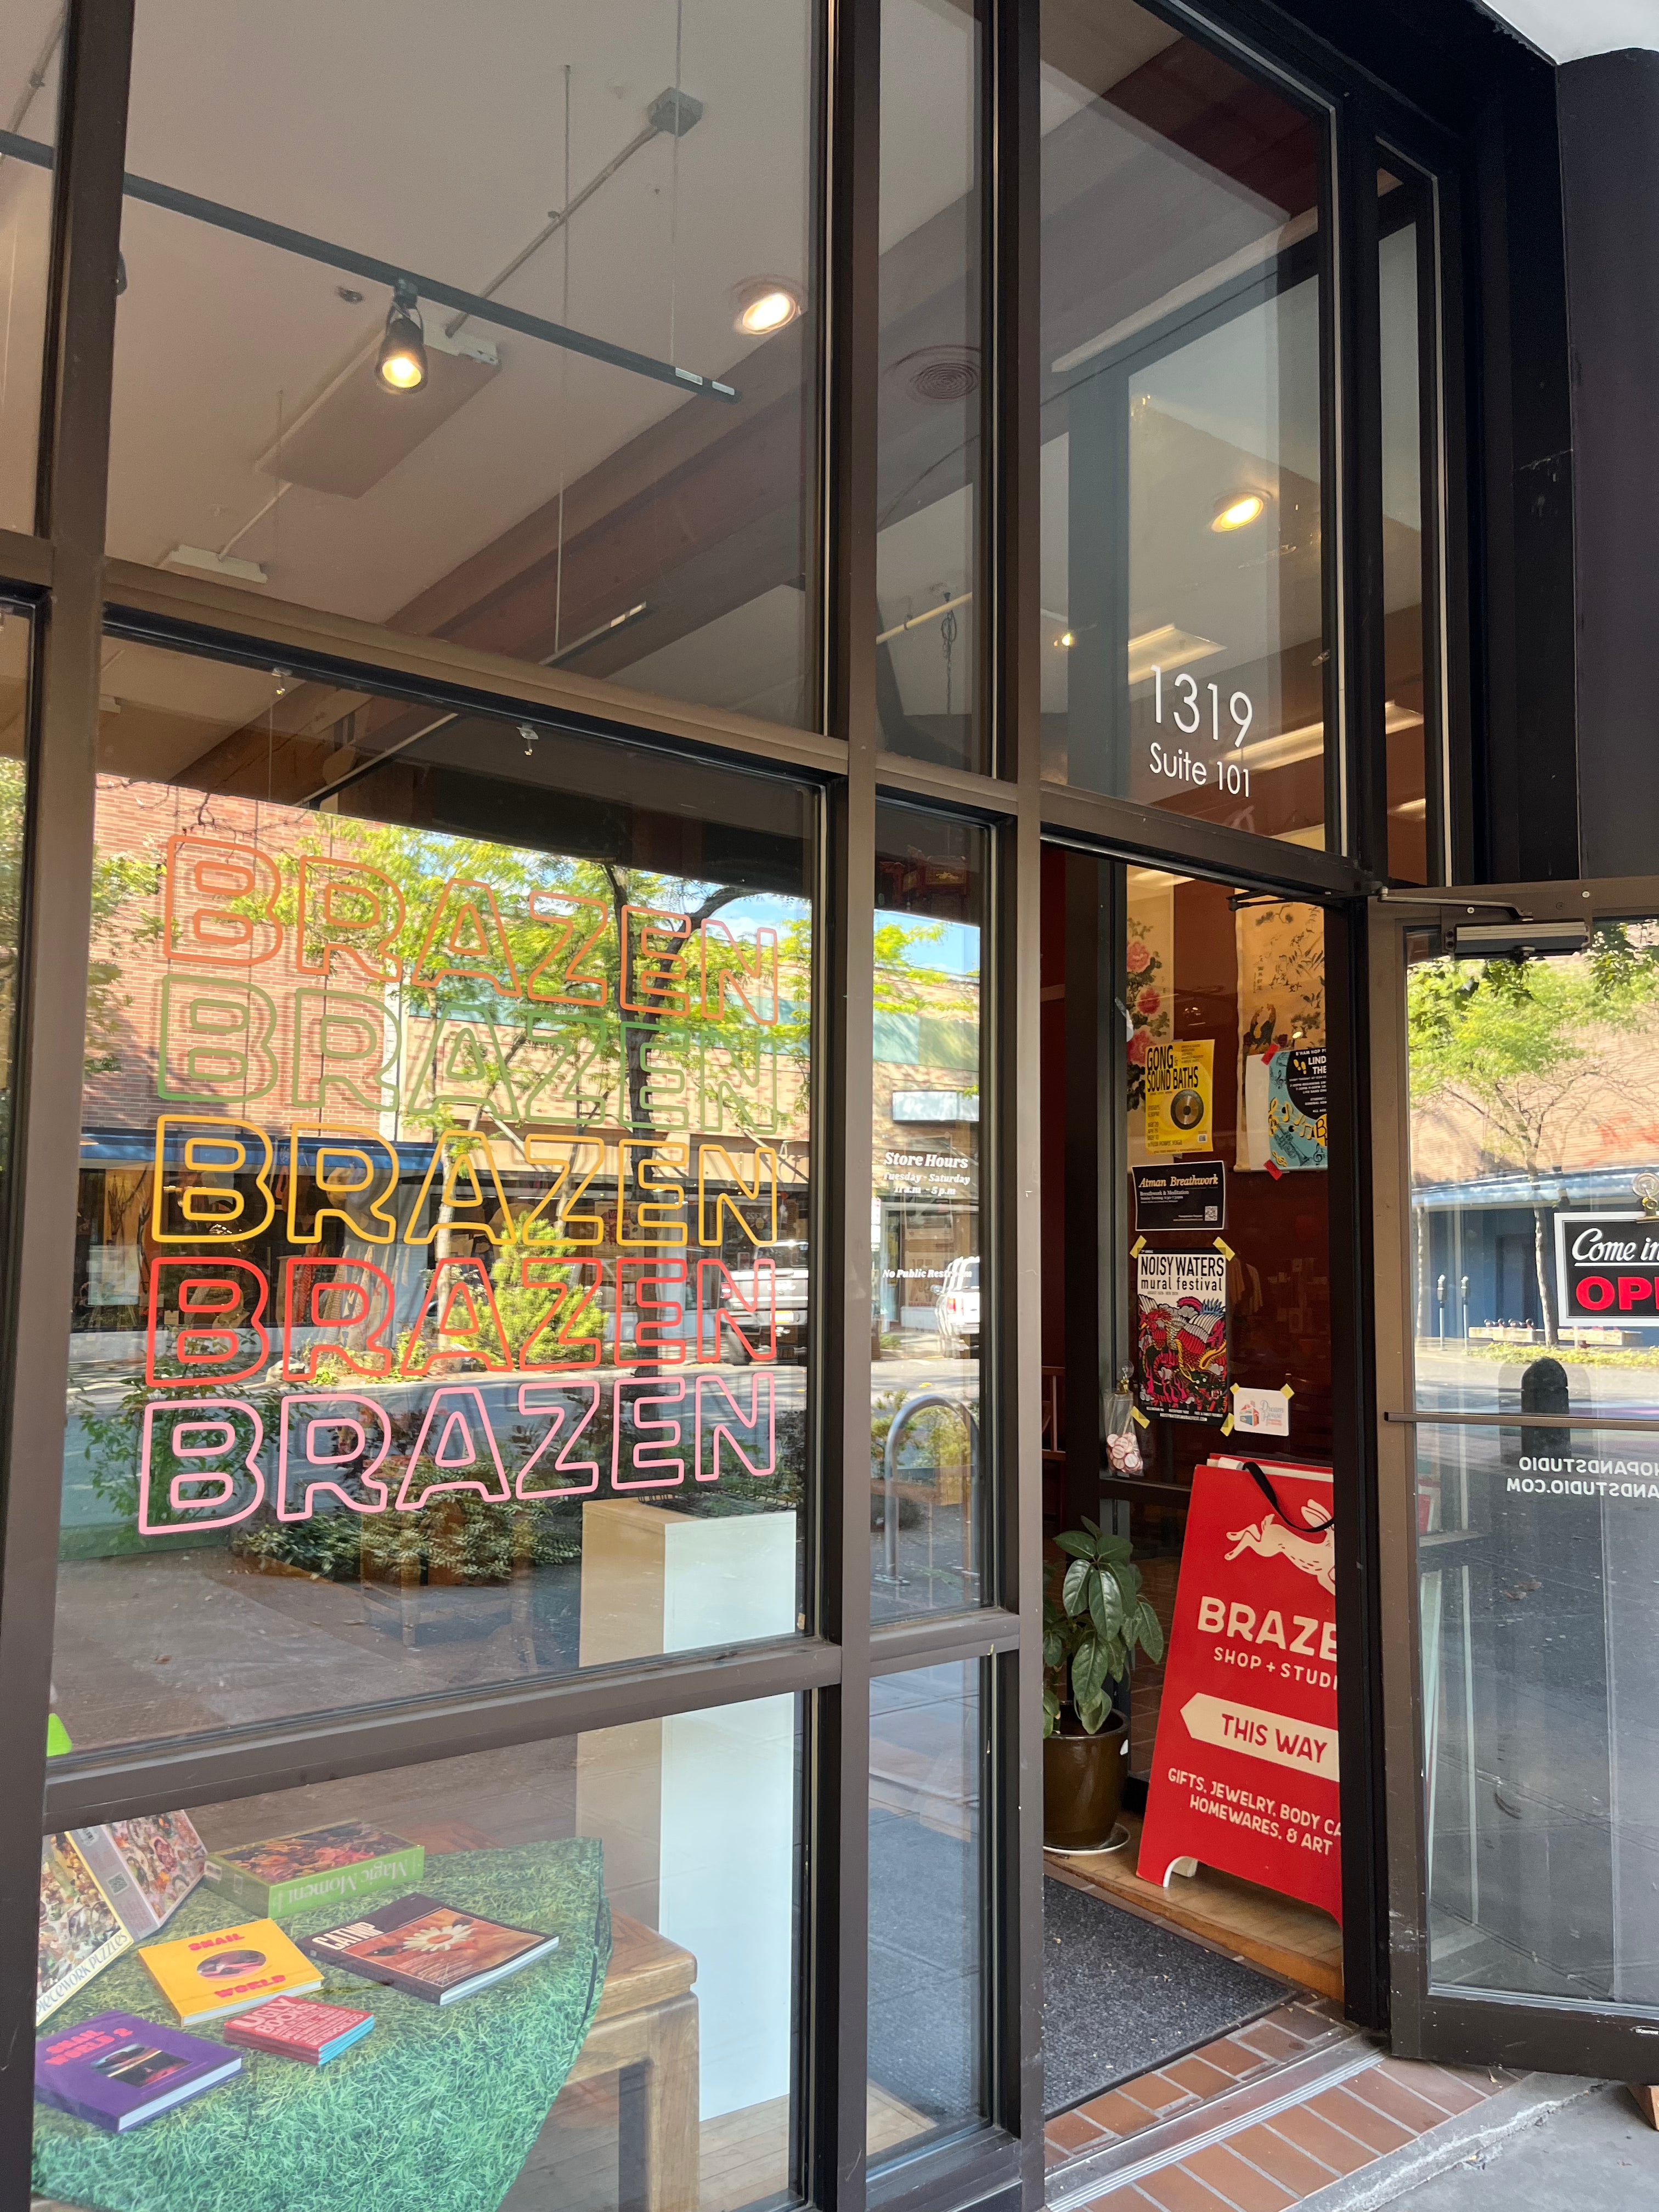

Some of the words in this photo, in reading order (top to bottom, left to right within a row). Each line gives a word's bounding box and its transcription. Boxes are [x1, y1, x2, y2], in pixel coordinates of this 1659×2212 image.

[1150, 664, 1253, 748] 1319
[1149, 742, 1207, 785] Suite
[1216, 761, 1249, 797] 101
[163, 835, 778, 1026] BRAZEN
[157, 974, 778, 1135] BRAZEN
[1147, 1045, 1173, 1071] GONG
[1147, 1069, 1171, 1092] SOUND
[1173, 1066, 1199, 1090] BATHS
[883, 1152, 924, 1166] Store
[924, 1154, 969, 1169] Hours
[151, 1114, 778, 1247] BRAZEN
[883, 1172, 922, 1183] Tuesday
[928, 1173, 970, 1186] Saturday
[930, 1186, 938, 1194] 5
[1138, 1177, 1166, 1188] Atman
[1169, 1173, 1219, 1187] Breathwork
[1571, 1227, 1637, 1261] Come
[882, 1269, 896, 1278] No
[896, 1268, 927, 1278] Public
[927, 1269, 973, 1278] Restrm
[1141, 1256, 1173, 1276] NOISY
[1175, 1256, 1224, 1277] WATERS
[1141, 1276, 1172, 1290] mural
[1176, 1277, 1222, 1291] festival
[1576, 1276, 1659, 1311] OP
[145, 1256, 776, 1386] BRAZEN
[139, 1372, 776, 1535] BRAZEN
[1213, 1646, 1262, 1669] SHOP
[1221, 1713, 1268, 1746] THIS
[1275, 1728, 1328, 1763] WAY
[1280, 1804, 1321, 1830] BODY
[1301, 1833, 1334, 1855] ART
[312, 1922, 385, 1950] CATNIP
[231, 1997, 298, 2028] UGLY
[255, 2003, 318, 2034] BOOKS
